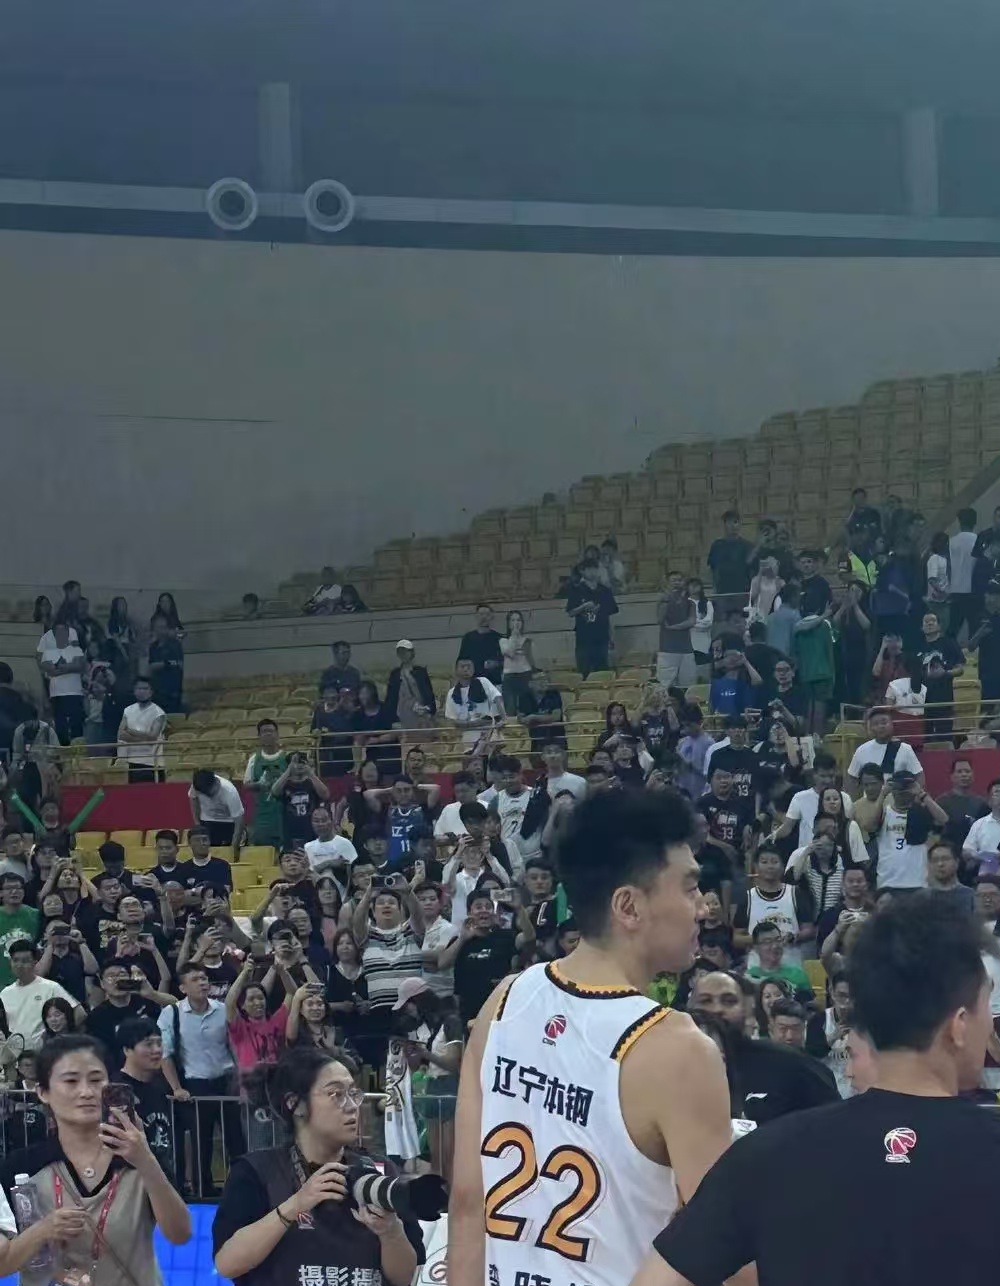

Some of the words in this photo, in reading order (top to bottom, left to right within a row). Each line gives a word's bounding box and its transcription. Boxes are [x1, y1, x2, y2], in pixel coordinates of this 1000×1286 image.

[738, 784, 749, 797] 13
[295, 804, 307, 816] 13
[721, 827, 734, 840] 13
[491, 1055, 594, 1127] 辽宁本钢
[481, 1121, 603, 1263] 22
